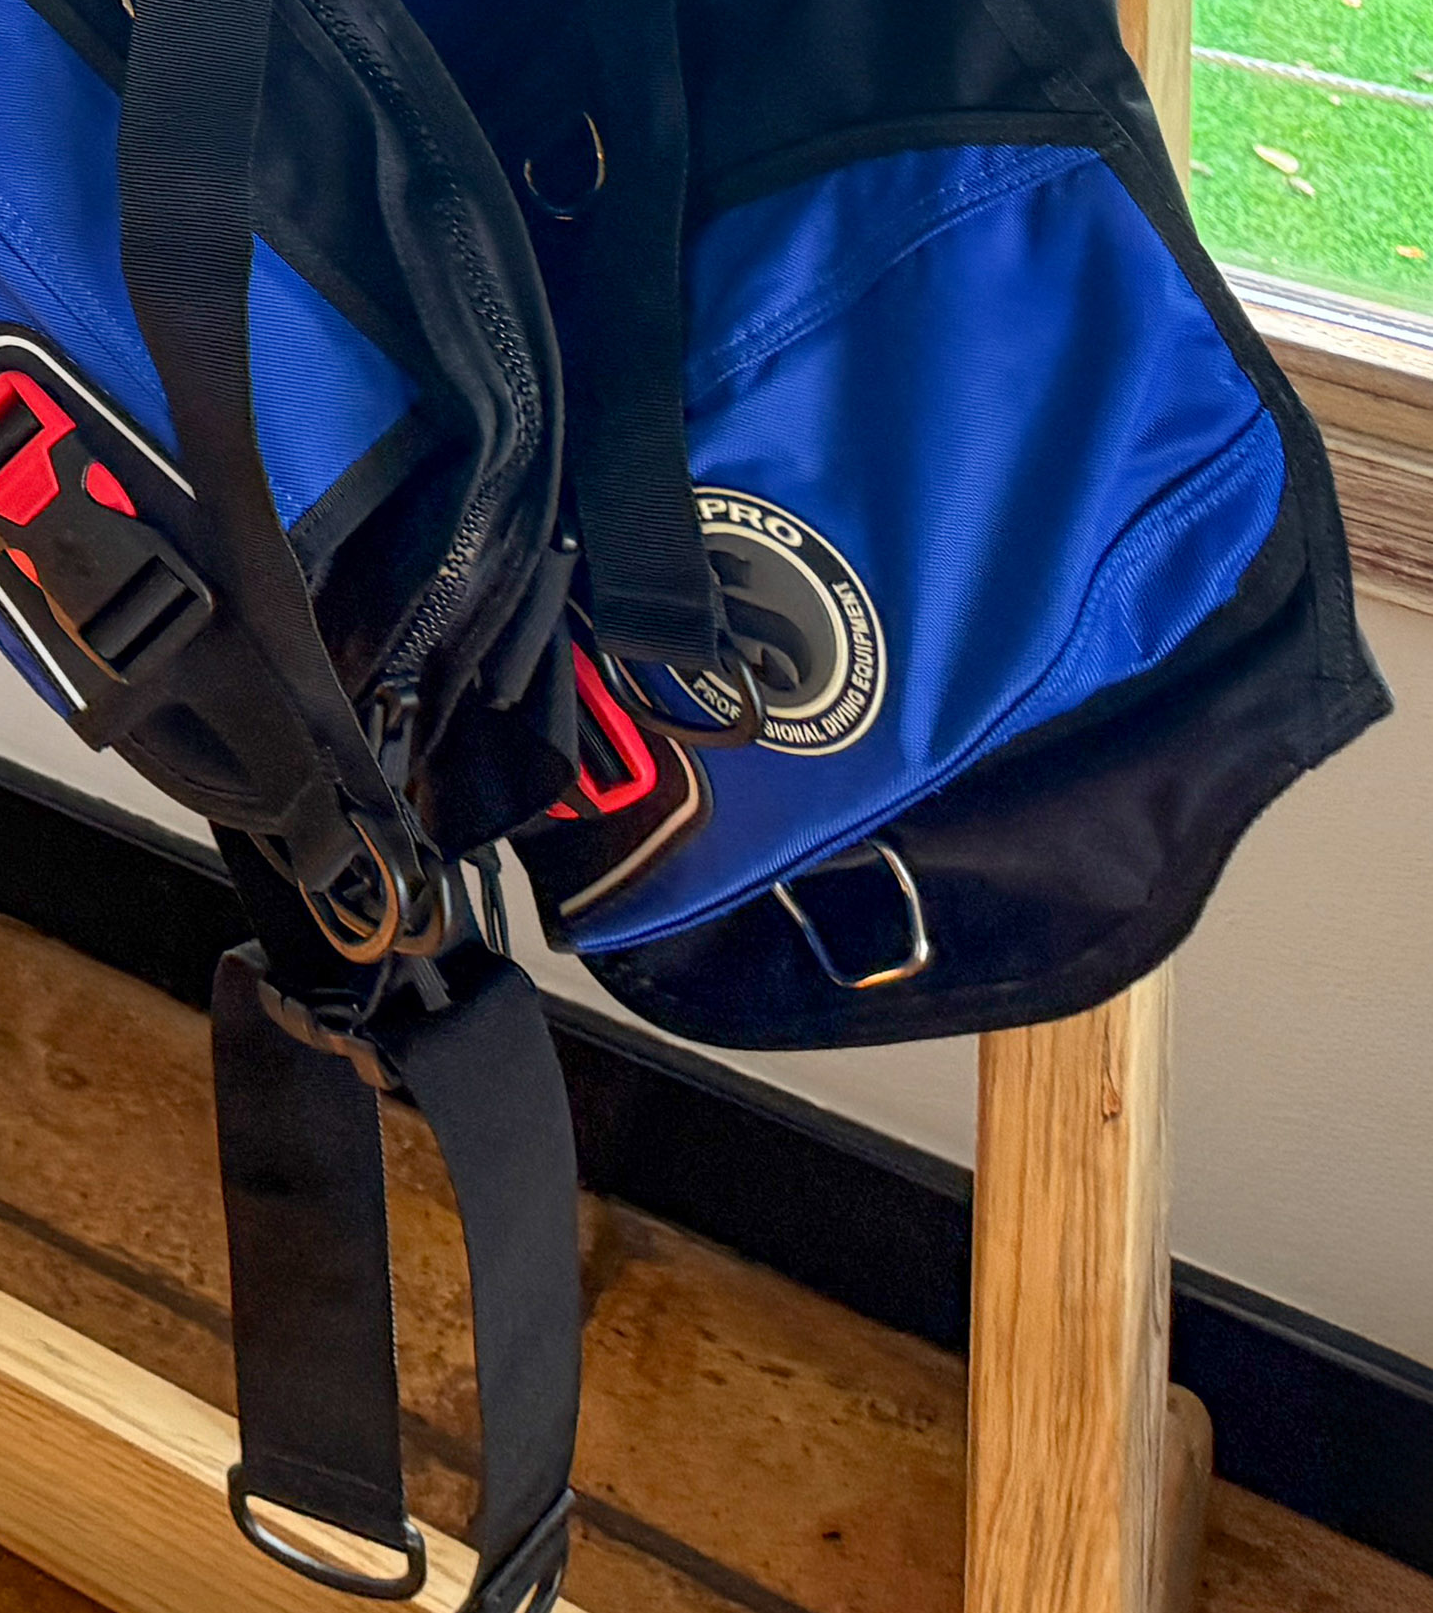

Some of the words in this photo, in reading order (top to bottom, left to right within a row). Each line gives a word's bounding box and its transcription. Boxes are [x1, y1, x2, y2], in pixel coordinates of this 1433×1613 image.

[697, 497, 803, 548] PRO
[831, 579, 876, 693] EQUIPMENT
[692, 677, 825, 743] PROFSIONAL
[824, 687, 866, 735] DIVING
